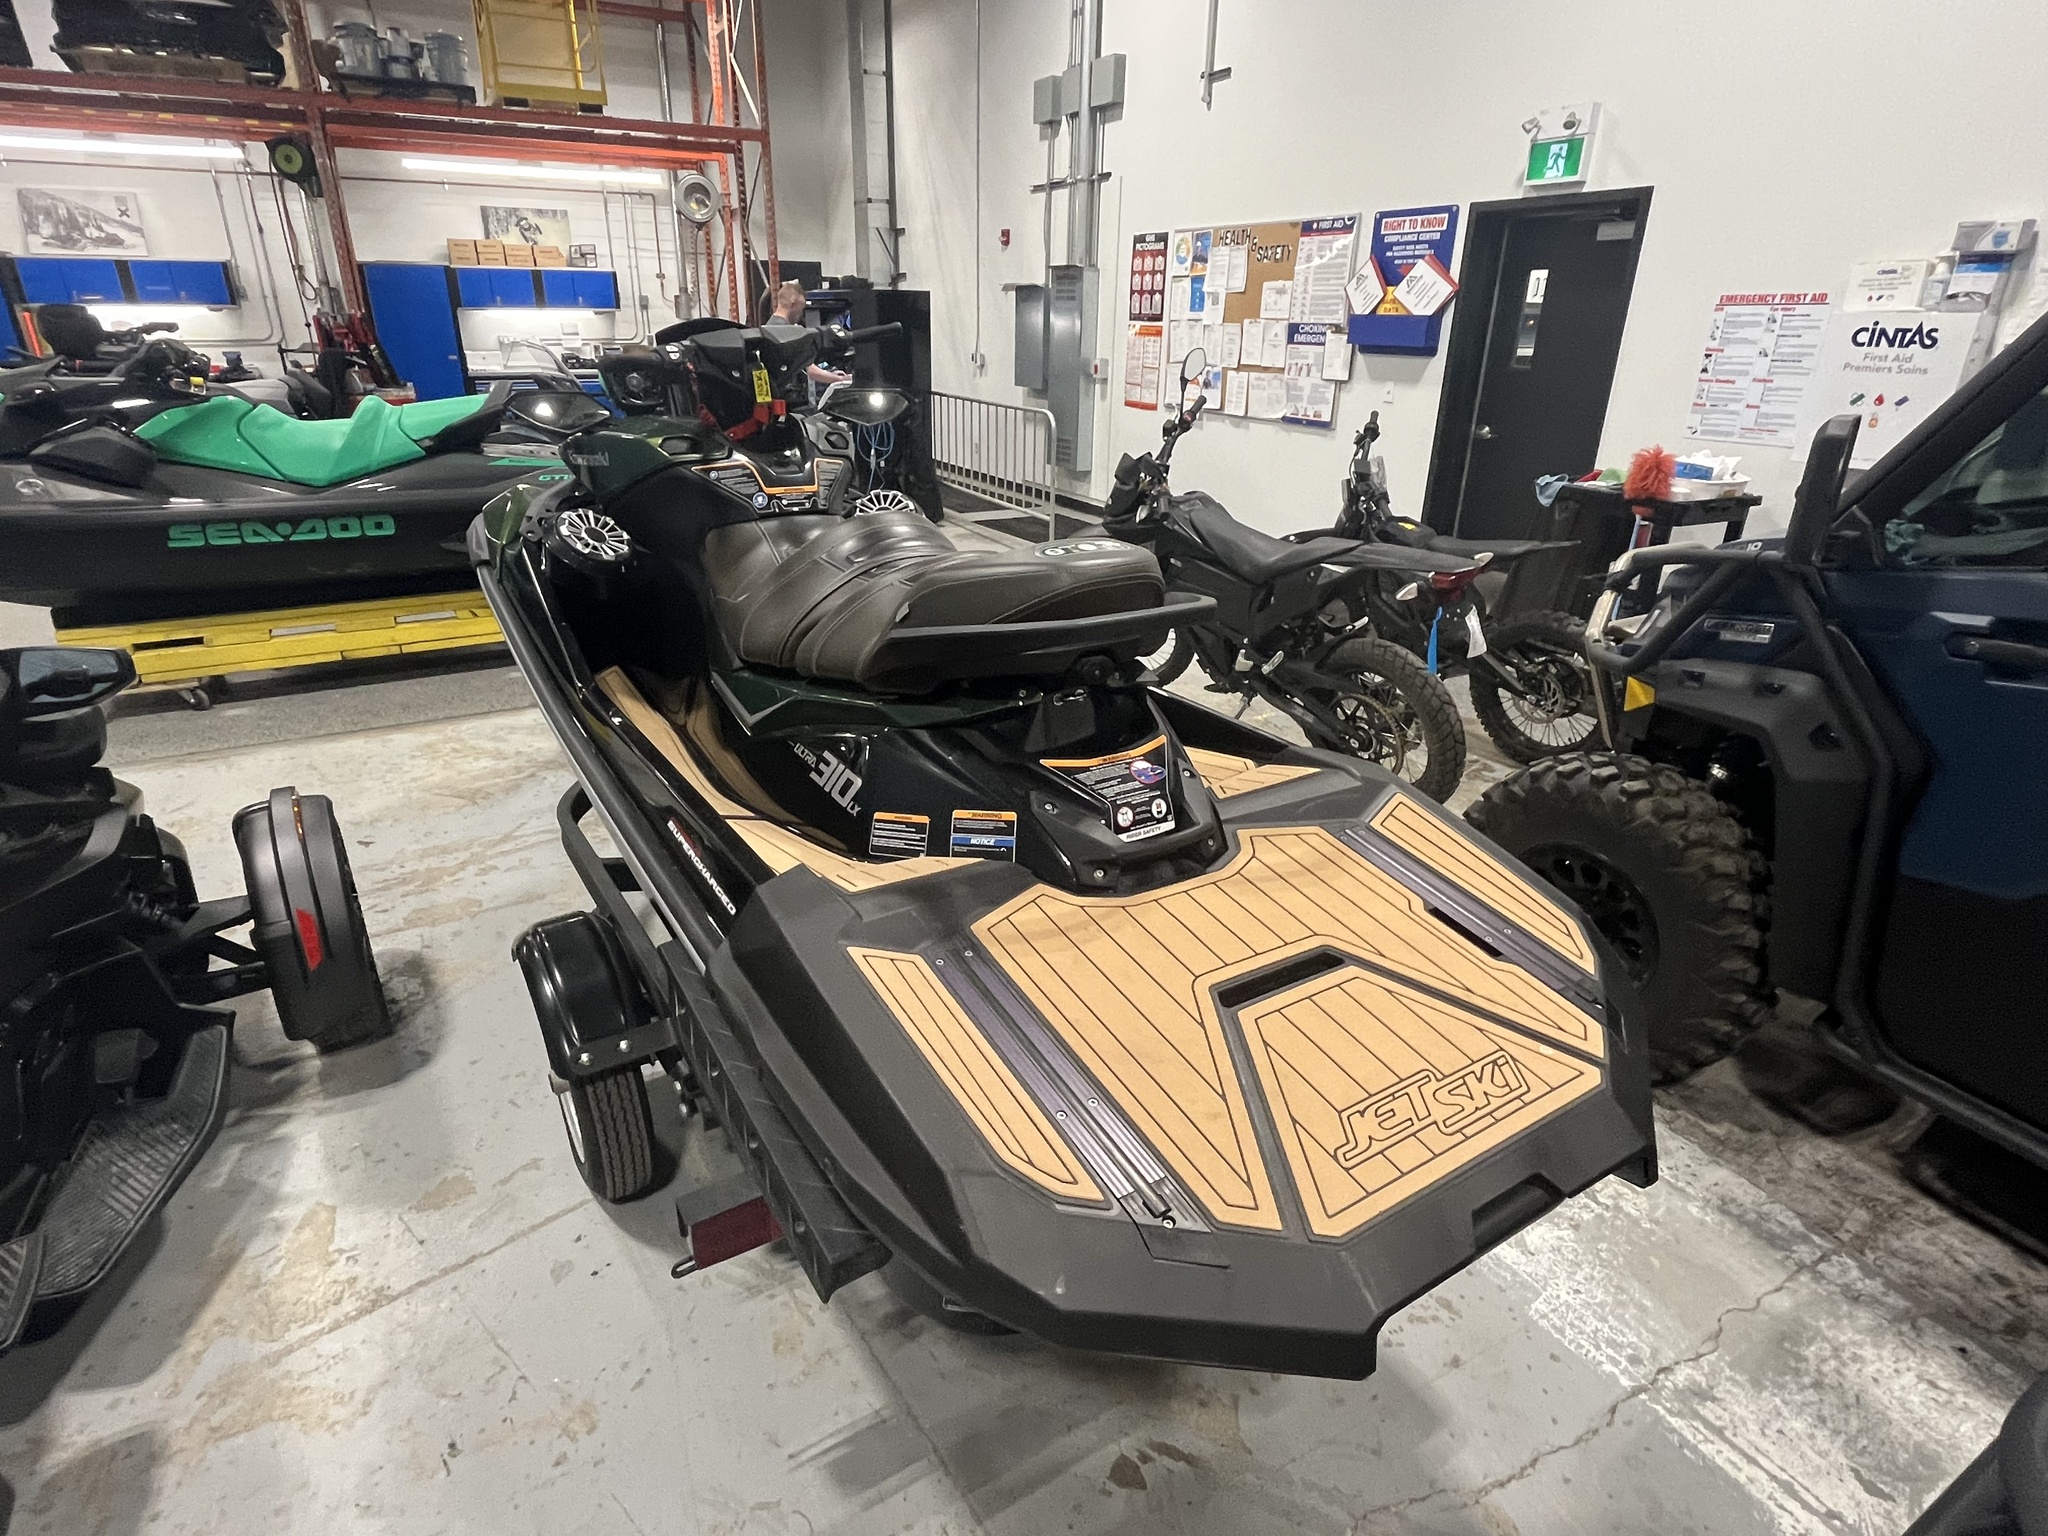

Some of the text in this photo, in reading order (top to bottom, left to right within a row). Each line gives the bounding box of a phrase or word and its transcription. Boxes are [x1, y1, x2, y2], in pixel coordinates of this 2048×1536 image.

[1318, 220, 1344, 230] FIRST AID
[1383, 216, 1446, 232] RIGHT TO KNOW
[1384, 232, 1441, 242] COMPLIANCE CENTER
[1218, 229, 1292, 263] HEALTH & SAFETY
[1719, 292, 1828, 304] EMERGENCY FIRST AID
[1293, 333, 1326, 343] EMERGEN
[1863, 352, 1914, 364] First Aid
[1843, 362, 1928, 375] Premiers Soins
[793, 742, 862, 816] ULTRA 310 LX
[1143, 826, 1162, 836] SAFETY
[970, 838, 996, 846] NOTICE
[667, 820, 736, 916] SUPERCHARGED
[1342, 1073, 1432, 1162] JET
